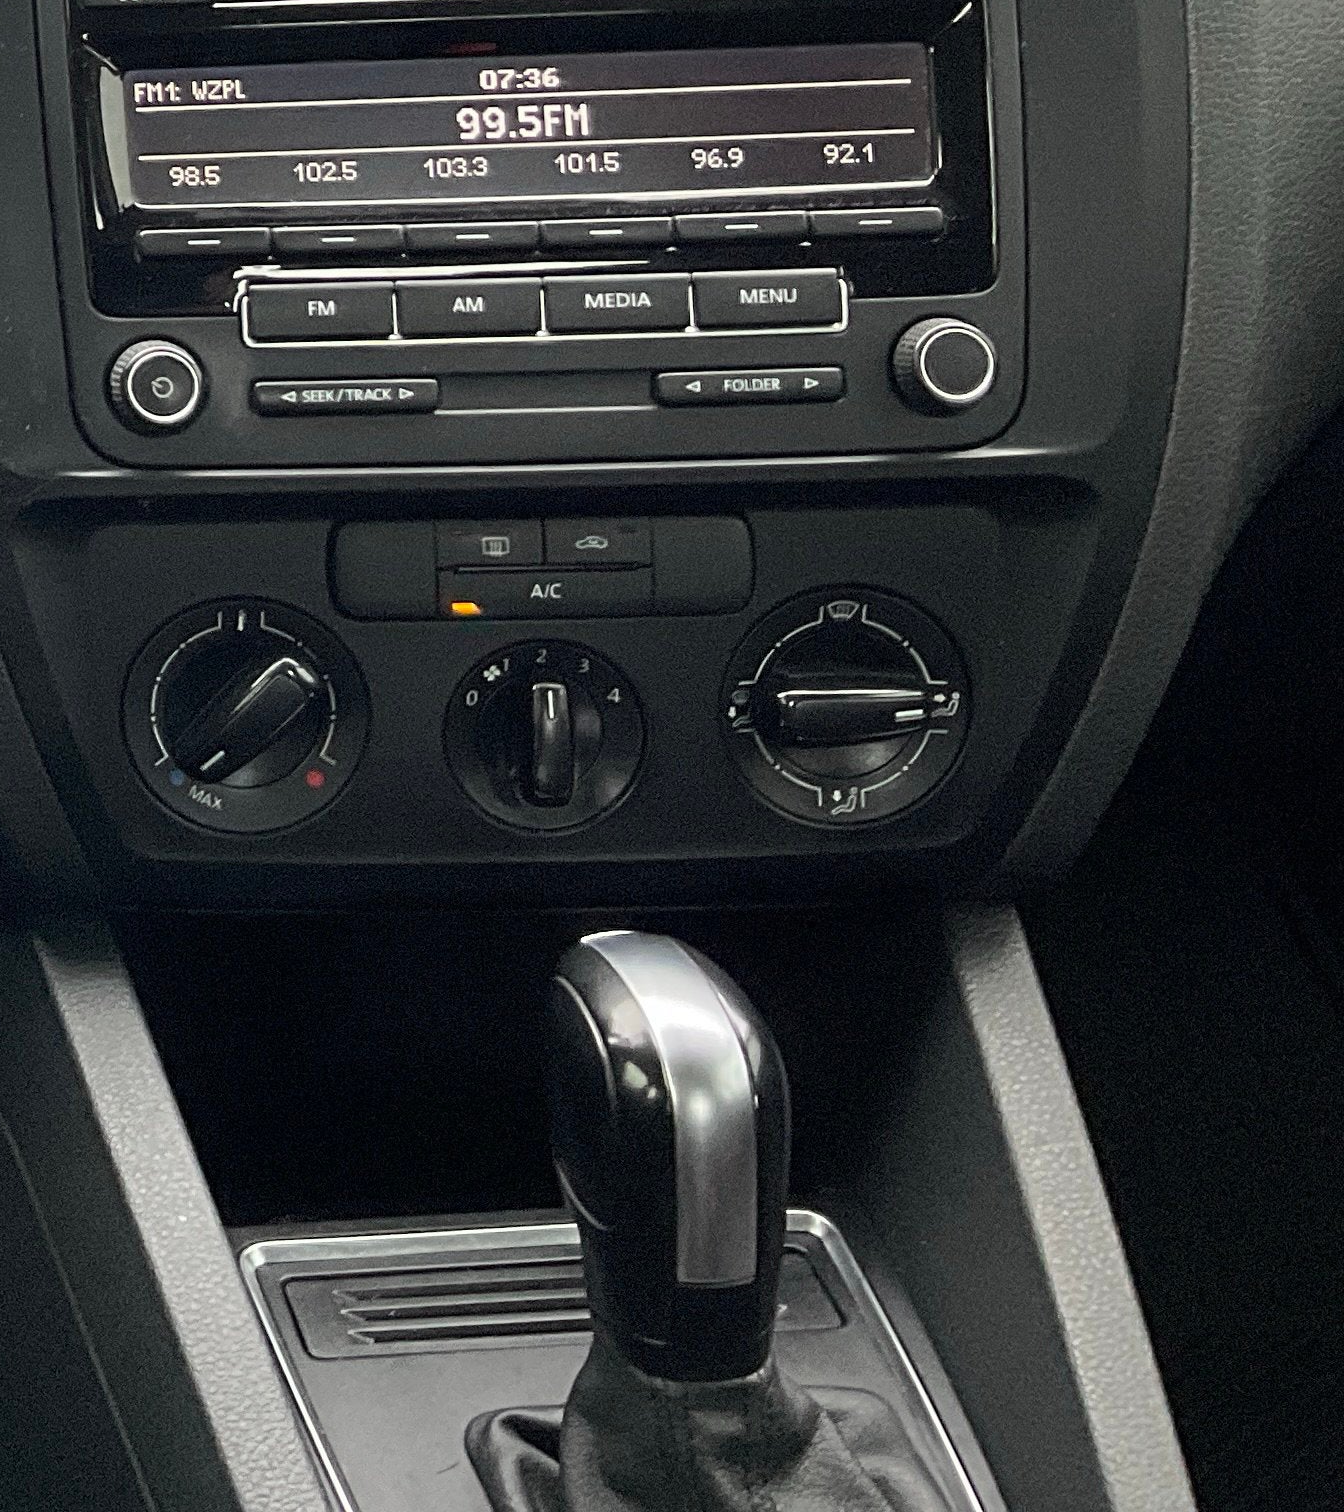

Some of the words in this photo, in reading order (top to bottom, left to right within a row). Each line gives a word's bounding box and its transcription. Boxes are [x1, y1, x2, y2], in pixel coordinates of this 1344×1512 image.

[191, 79, 246, 102] WZPL
[478, 68, 561, 91] 07:36
[455, 103, 589, 141] 99.5FM
[168, 165, 221, 187] 98.5
[292, 159, 358, 184] 102.5
[423, 156, 489, 180] 103.3
[553, 150, 621, 175] 101.5
[690, 146, 744, 170] 96.9
[822, 141, 875, 165] 92.1
[452, 296, 485, 313] AM
[583, 291, 652, 310] MEDIA
[738, 287, 799, 305] MENU
[307, 300, 337, 317] FM
[723, 376, 782, 393] FOLDER
[530, 582, 563, 600] A/C
[535, 647, 548, 664] 2
[502, 657, 511, 672] 1
[577, 657, 590, 673] 3
[606, 688, 622, 704] 4
[188, 784, 223, 811] MAX
